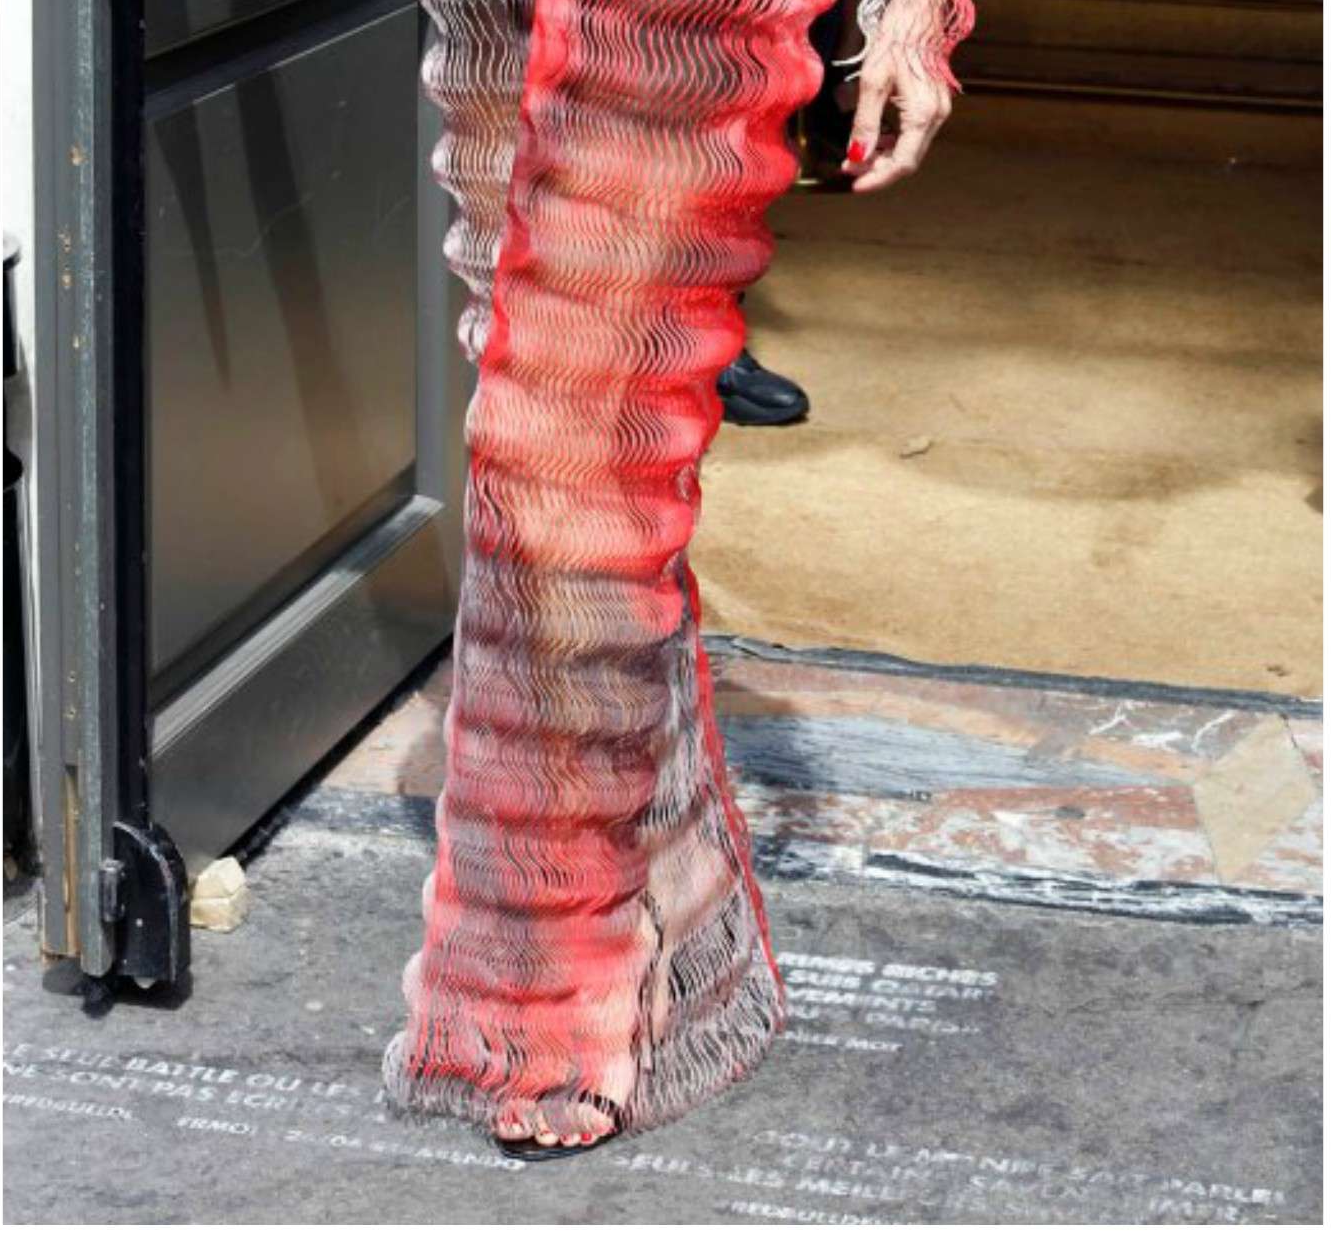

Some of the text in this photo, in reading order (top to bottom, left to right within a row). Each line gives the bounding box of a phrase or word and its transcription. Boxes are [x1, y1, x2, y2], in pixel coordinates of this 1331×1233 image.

[123, 1056, 238, 1085] BATTLE
[246, 1072, 302, 1093] OU
[152, 1079, 217, 1103] PAS
